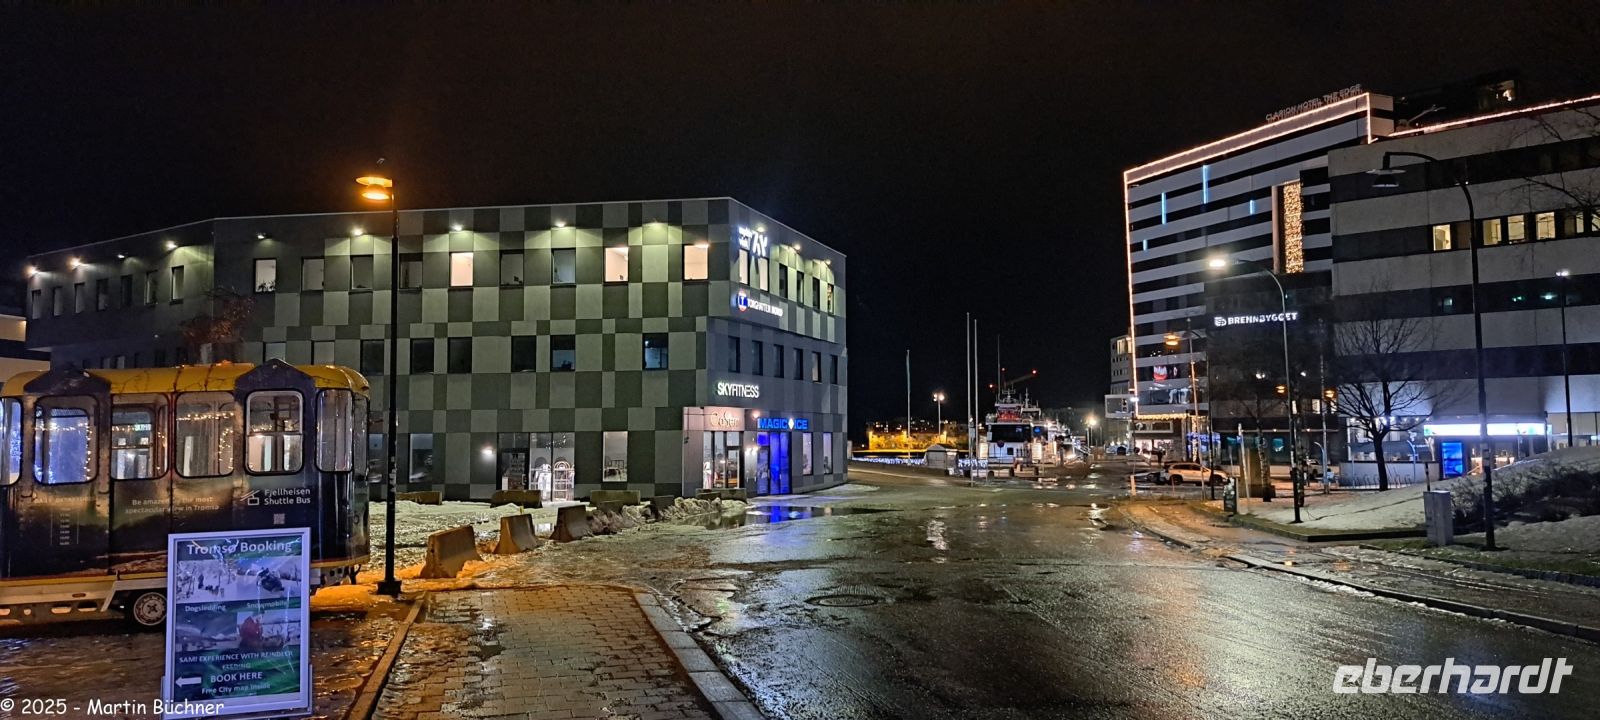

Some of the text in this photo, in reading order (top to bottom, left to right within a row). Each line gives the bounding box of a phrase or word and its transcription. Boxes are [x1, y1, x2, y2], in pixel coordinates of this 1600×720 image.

[1297, 98, 1321, 113] HOTEL
[1323, 92, 1338, 103] THE
[1340, 84, 1361, 99] EDGE
[1228, 312, 1298, 325] BRENNBYGGET
[717, 381, 760, 399] SKYFITNESS
[758, 417, 808, 430] MAGIC ICE
[264, 488, 311, 497] Fjellheisen
[264, 496, 311, 505] Shuttle Bus
[187, 540, 292, 555] Tromsø Booking
[185, 604, 226, 613] Dogsledding
[199, 652, 239, 662] EXPERIENCE
[241, 651, 259, 660] WITH
[261, 650, 293, 658] REINDEER
[210, 671, 263, 684] BOOK HERE
[201, 686, 217, 695] Free
[218, 685, 232, 694] City
[233, 684, 249, 693] map
